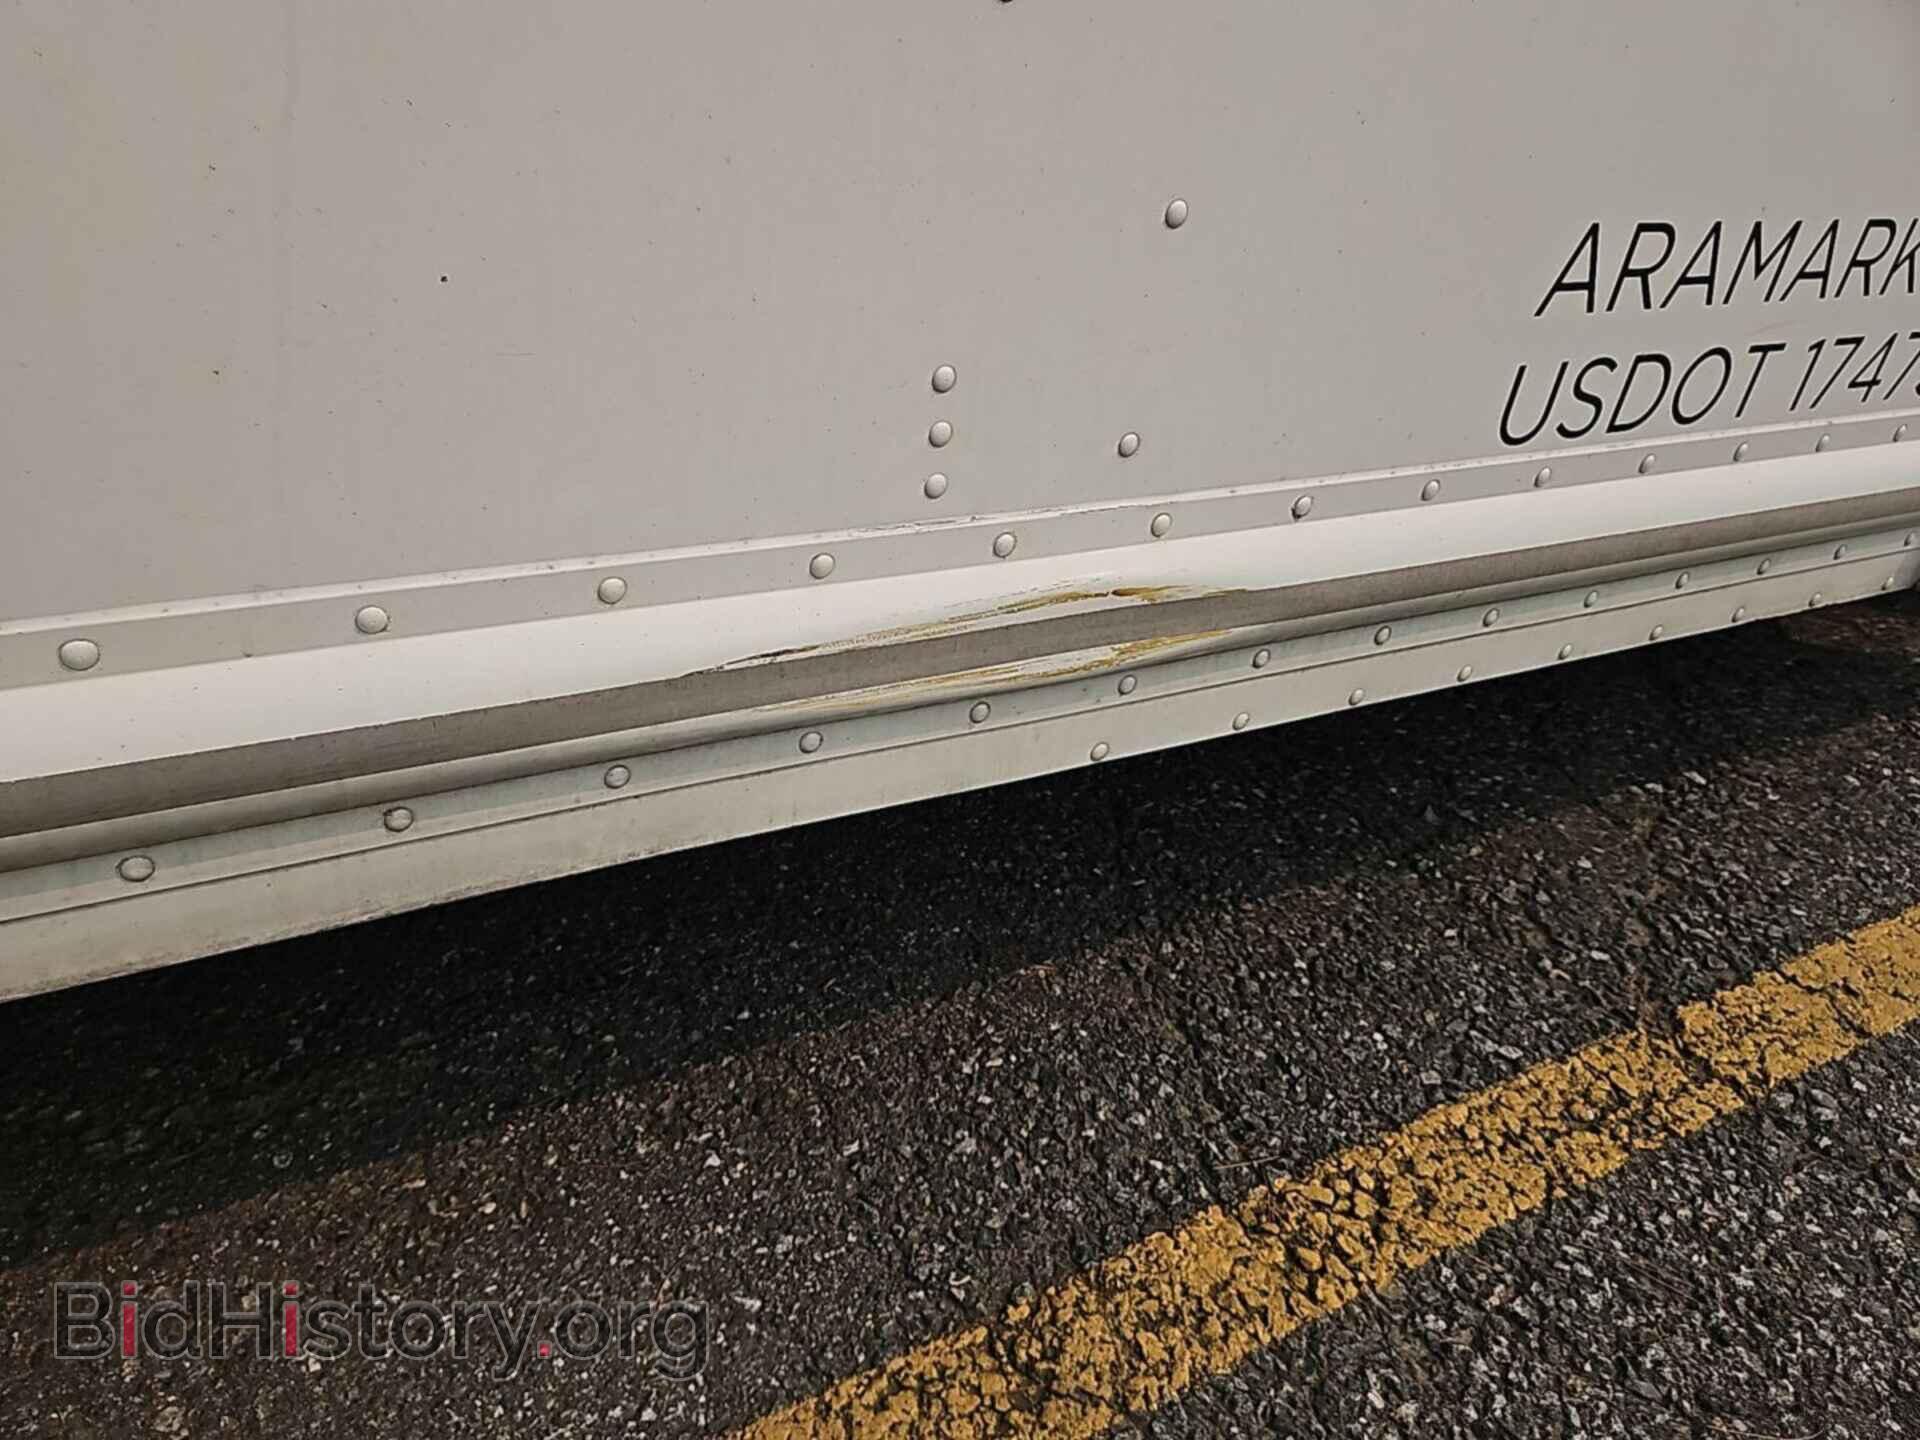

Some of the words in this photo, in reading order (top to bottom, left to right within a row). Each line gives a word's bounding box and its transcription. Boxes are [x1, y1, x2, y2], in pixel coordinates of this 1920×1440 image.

[1533, 218, 1920, 318] ARAMARK
[1499, 342, 1787, 446] USDOT
[1789, 330, 1920, 412] 1747
